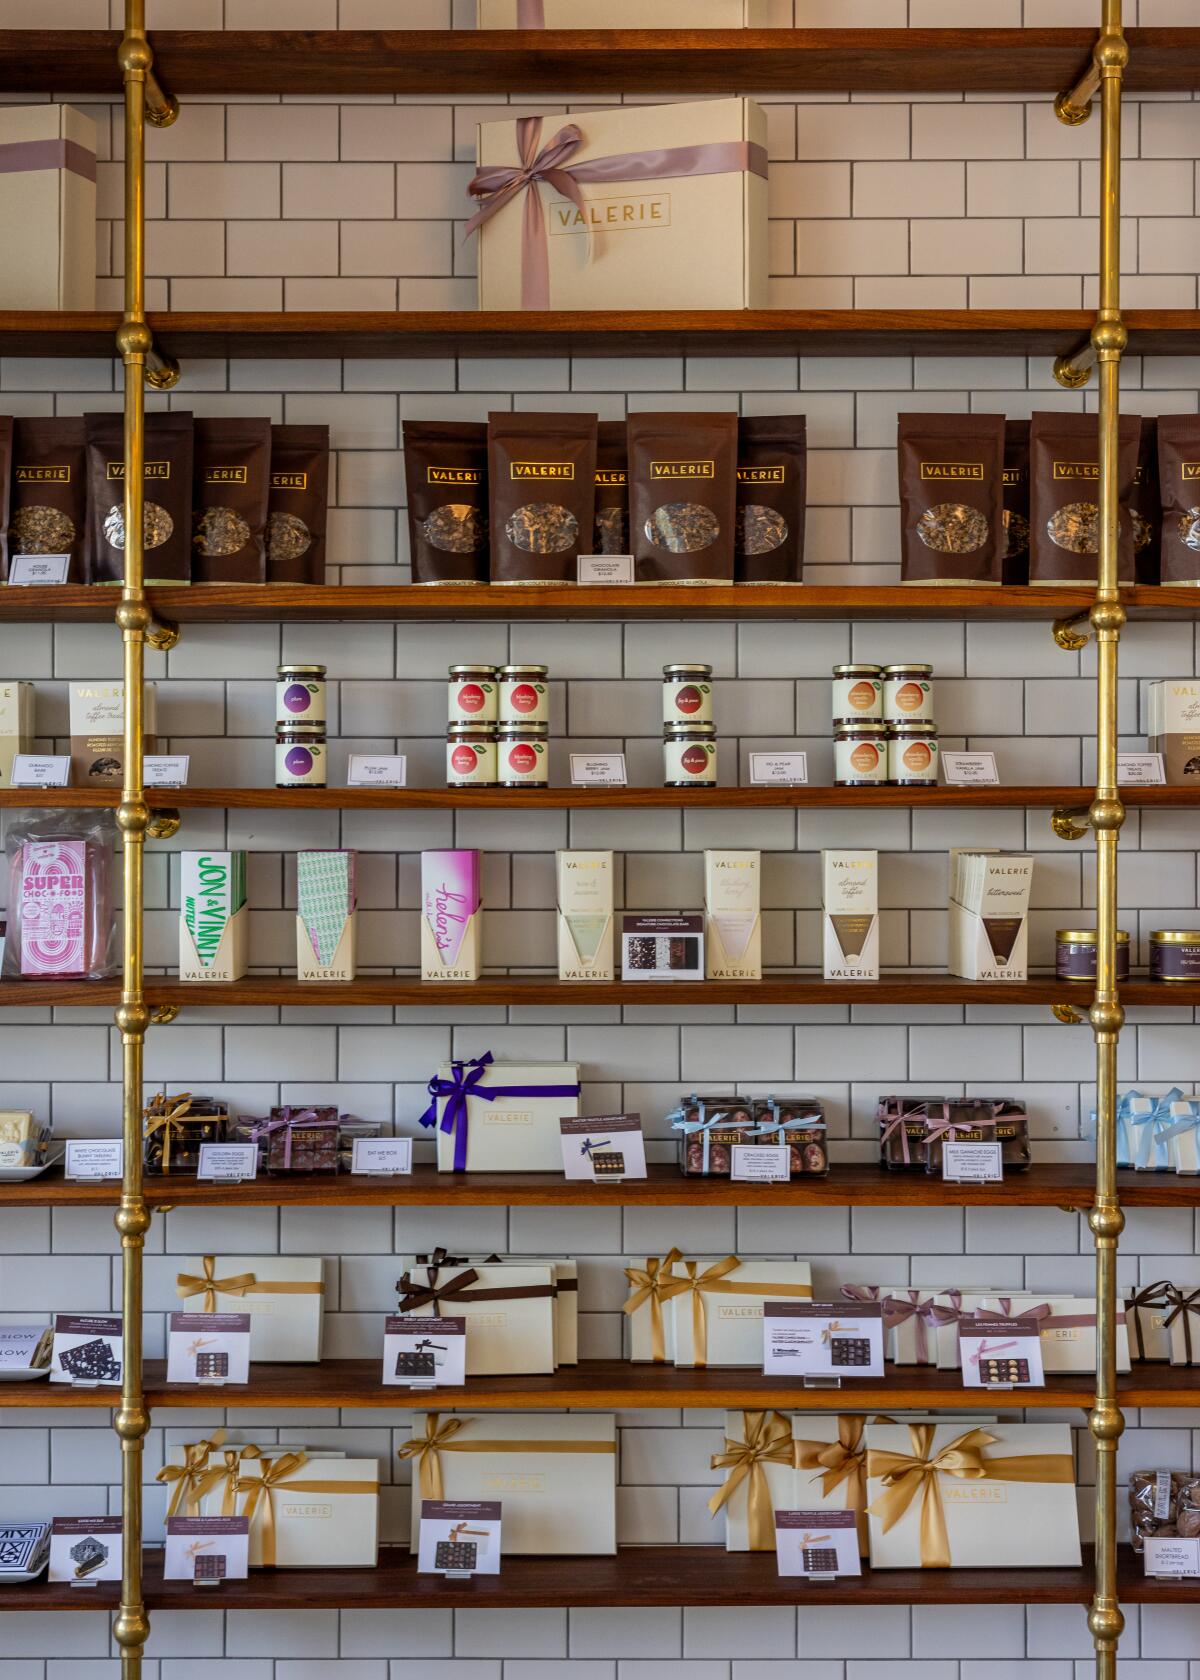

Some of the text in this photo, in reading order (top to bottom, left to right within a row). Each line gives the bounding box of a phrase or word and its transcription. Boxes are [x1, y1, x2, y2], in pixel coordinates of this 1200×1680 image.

[559, 202, 663, 227] VALERIE
[112, 465, 167, 476] VARIE
[515, 466, 570, 476] VALERIE
[655, 465, 710, 475] VALERIE
[926, 466, 980, 476] VALERIE
[1058, 466, 1099, 476] VALER
[594, 474, 626, 482] ALER
[737, 471, 780, 480] ALERIE
[198, 856, 227, 896] JON
[24, 875, 83, 890] SUPER
[986, 888, 1025, 896] bittersweet
[207, 899, 218, 907] &
[435, 883, 467, 950] helen's
[303, 970, 346, 978] VALERIE
[427, 970, 471, 978] VALERIE
[565, 970, 609, 978] VALERIE
[488, 1114, 529, 1122] VALERIE
[944, 1489, 1001, 1499] VALERIE
